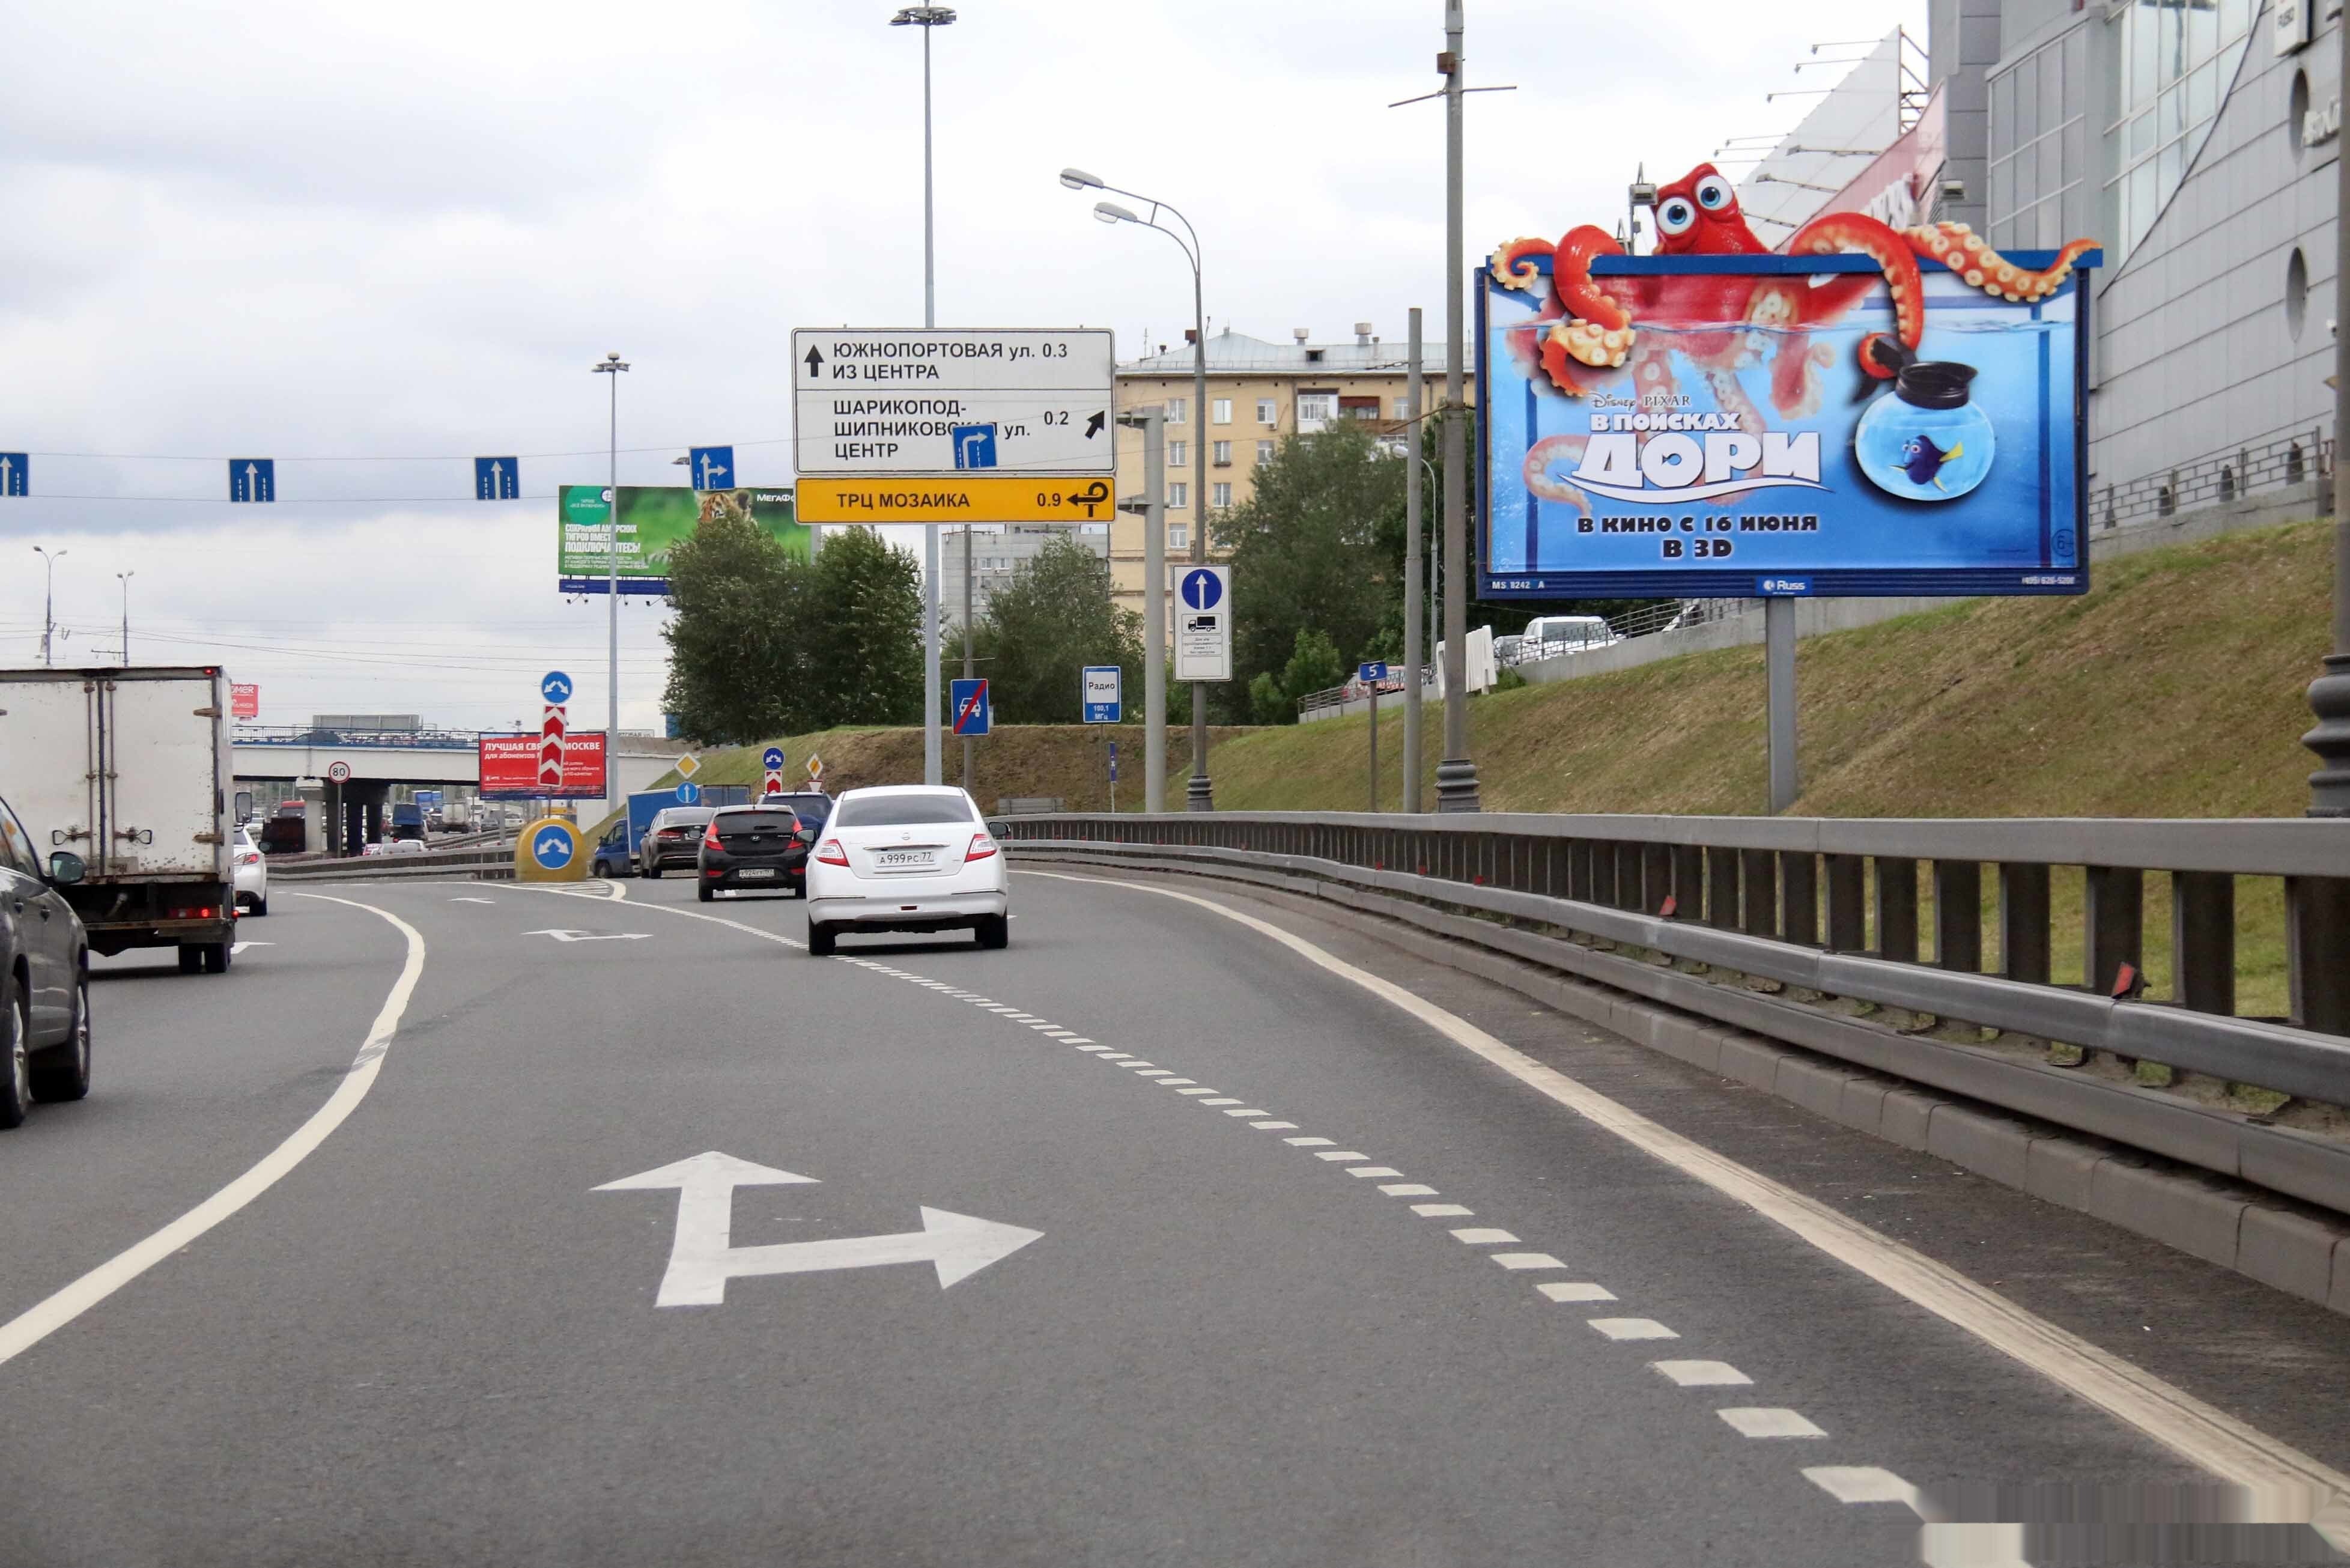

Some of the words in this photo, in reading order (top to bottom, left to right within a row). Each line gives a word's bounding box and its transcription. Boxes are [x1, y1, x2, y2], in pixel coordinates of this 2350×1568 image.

[833, 342, 1003, 358] ЮЖНОПОРТОВАЯ
[1009, 346, 1035, 361] ул.
[1042, 343, 1067, 358] 0.3
[833, 364, 857, 380] ИЗ
[863, 364, 940, 382] ЦЕНТРА
[833, 400, 967, 418] ШАРИКОПОД-
[1588, 391, 1636, 412] Disney
[1644, 395, 1691, 406] PIXAR
[1043, 411, 1069, 426] 0.2
[1590, 413, 1611, 431] В
[1614, 412, 1741, 431] ПОИСКАХ
[1004, 424, 1030, 440] ул.
[834, 443, 899, 461] ЦЕНТР
[1570, 431, 1824, 490] ДОРИ
[836, 493, 873, 511] ТРЦ
[879, 493, 970, 509] МОЗАИКА
[1036, 493, 1061, 508] 0.9
[1577, 518, 1594, 533] В
[1601, 517, 1672, 533] КИНО
[1680, 517, 1694, 532] С
[1705, 516, 1732, 532] 16
[1740, 515, 1817, 532] ИЮНЯ
[1662, 539, 1683, 558] В
[1694, 539, 1732, 558] 3D
[1492, 581, 1507, 589] MS
[1538, 580, 1545, 589] A
[1777, 580, 1806, 591] Russ
[1368, 663, 1380, 678] 5
[1088, 682, 1116, 691] Радио
[484, 743, 524, 752] ЛУЧШАЯ
[565, 742, 600, 750] МОСКВЕ
[332, 768, 345, 776] 80
